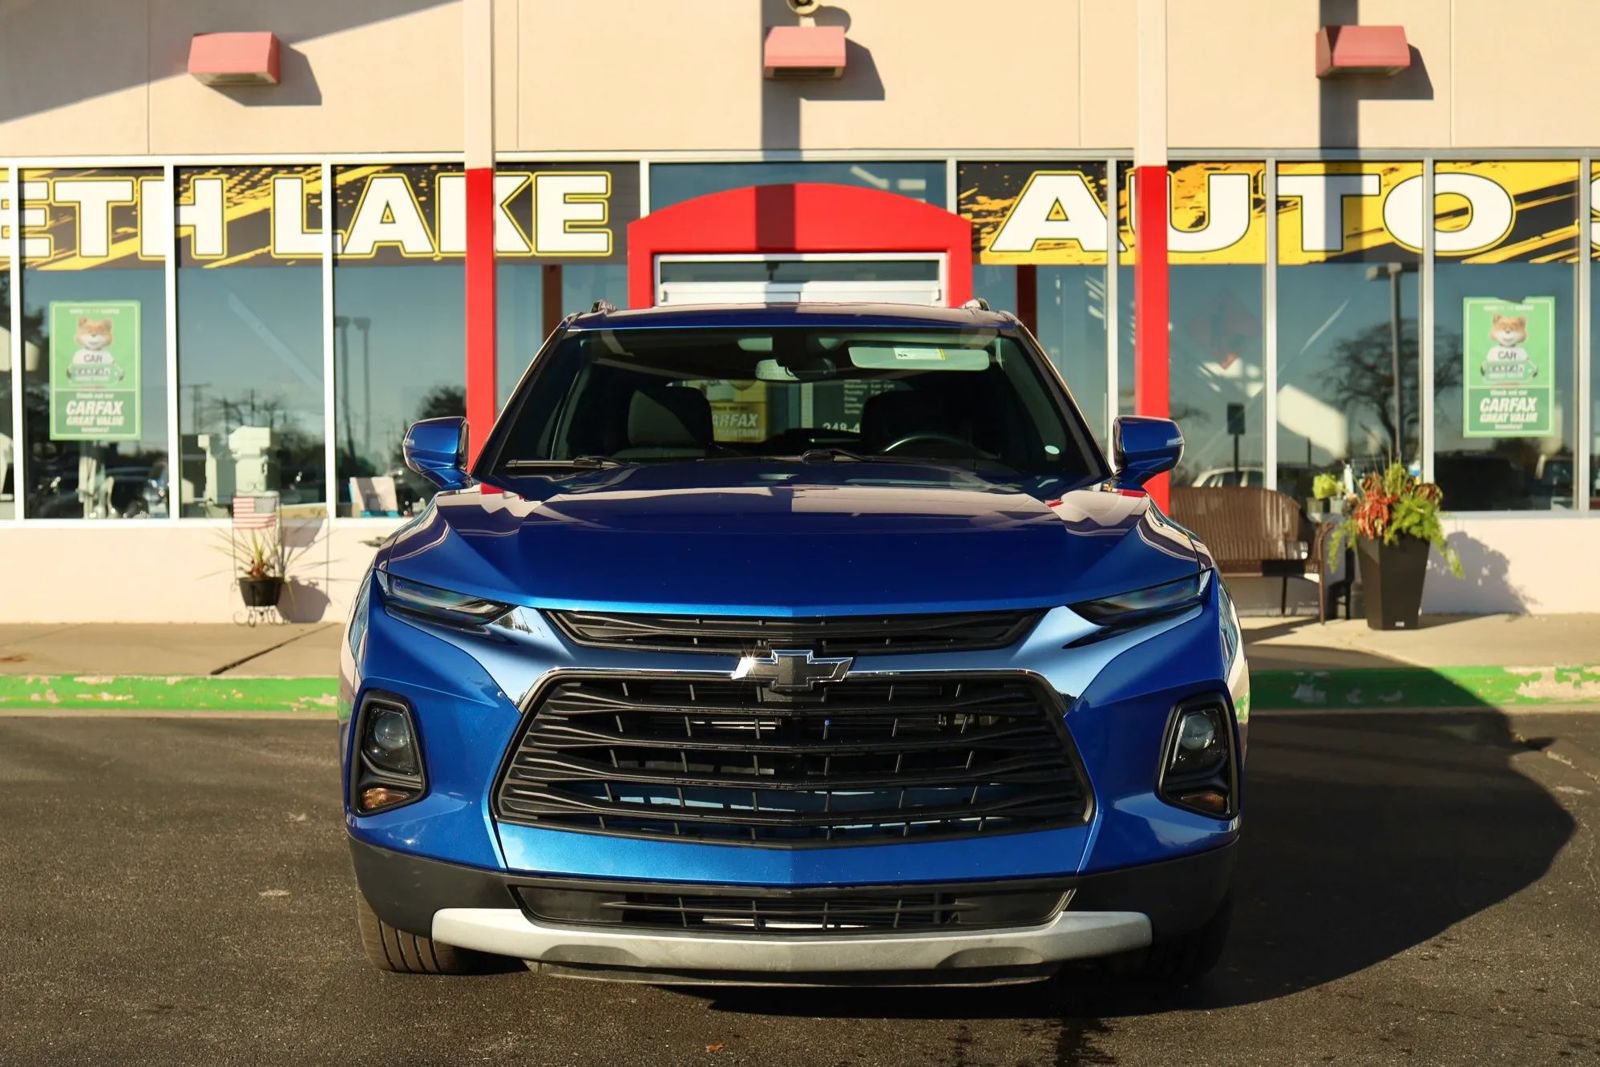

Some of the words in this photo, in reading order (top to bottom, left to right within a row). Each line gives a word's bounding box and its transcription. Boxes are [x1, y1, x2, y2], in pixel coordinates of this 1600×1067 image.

[271, 172, 612, 258] LAKE
[988, 170, 1514, 256] AUTO
[66, 400, 124, 416] CARFAX
[1480, 397, 1537, 413] CARFAX
